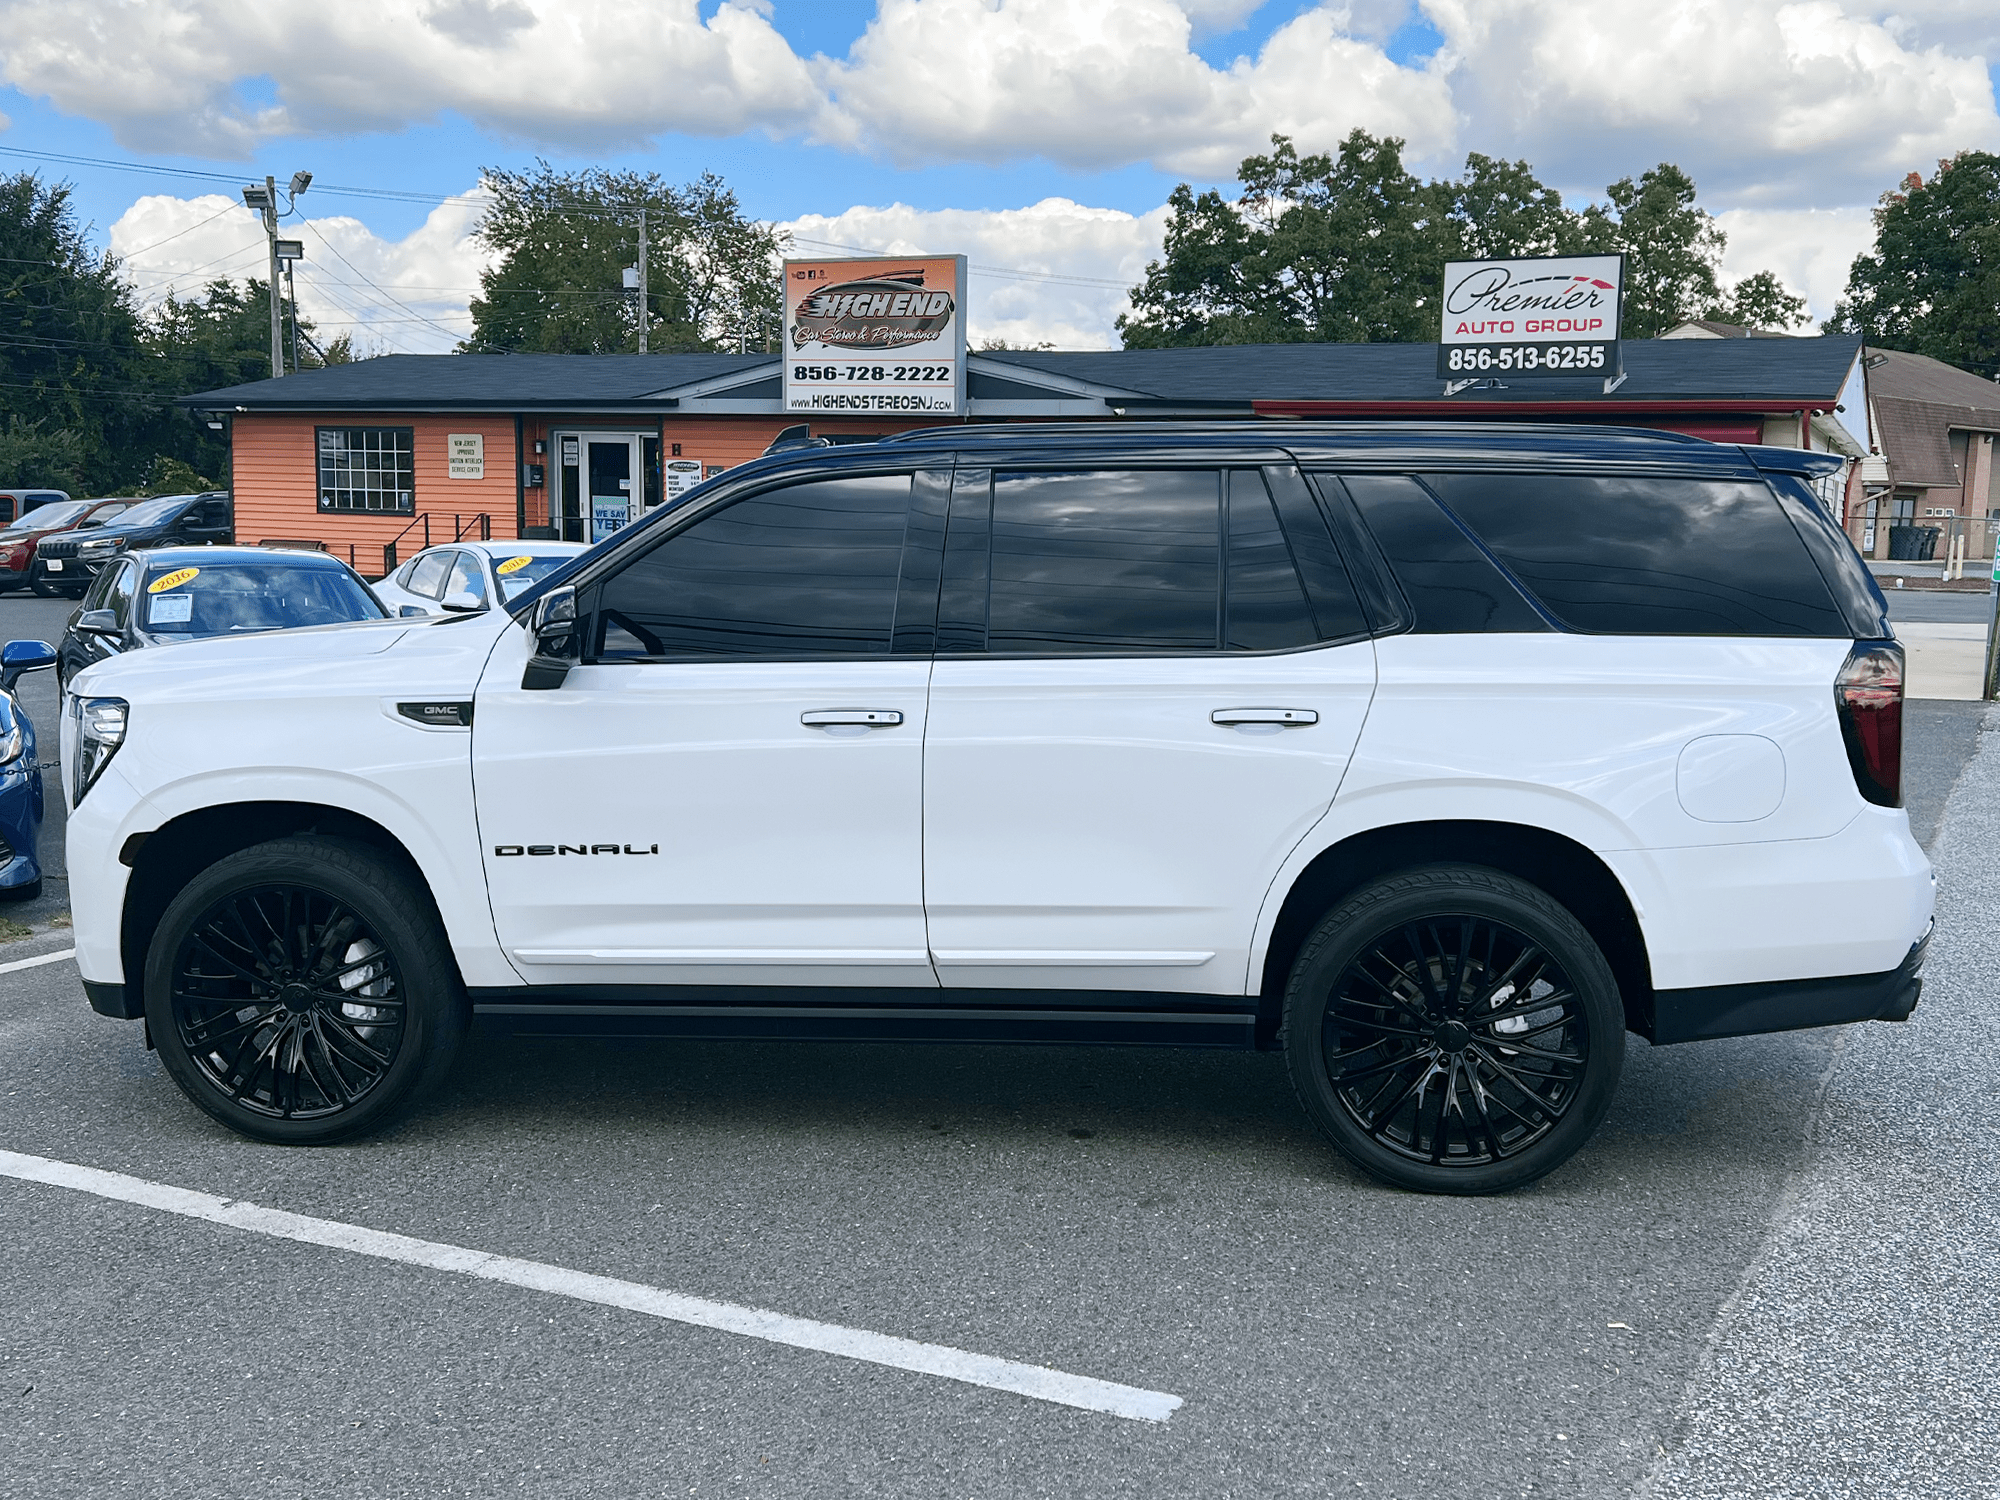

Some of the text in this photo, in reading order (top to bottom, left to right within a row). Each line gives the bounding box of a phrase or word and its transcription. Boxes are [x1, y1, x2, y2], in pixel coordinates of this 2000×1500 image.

[1447, 267, 1604, 314] Premier
[1455, 318, 1603, 335] AUTO GROUP
[795, 326, 940, 345] Car Stereo & Performance
[1449, 345, 1605, 371] 856-513-6255
[794, 366, 950, 381] 856-728-2222
[610, 510, 626, 518] SAY
[157, 571, 190, 590] 2016
[424, 706, 458, 714] GMC
[495, 844, 658, 856] DENALI
